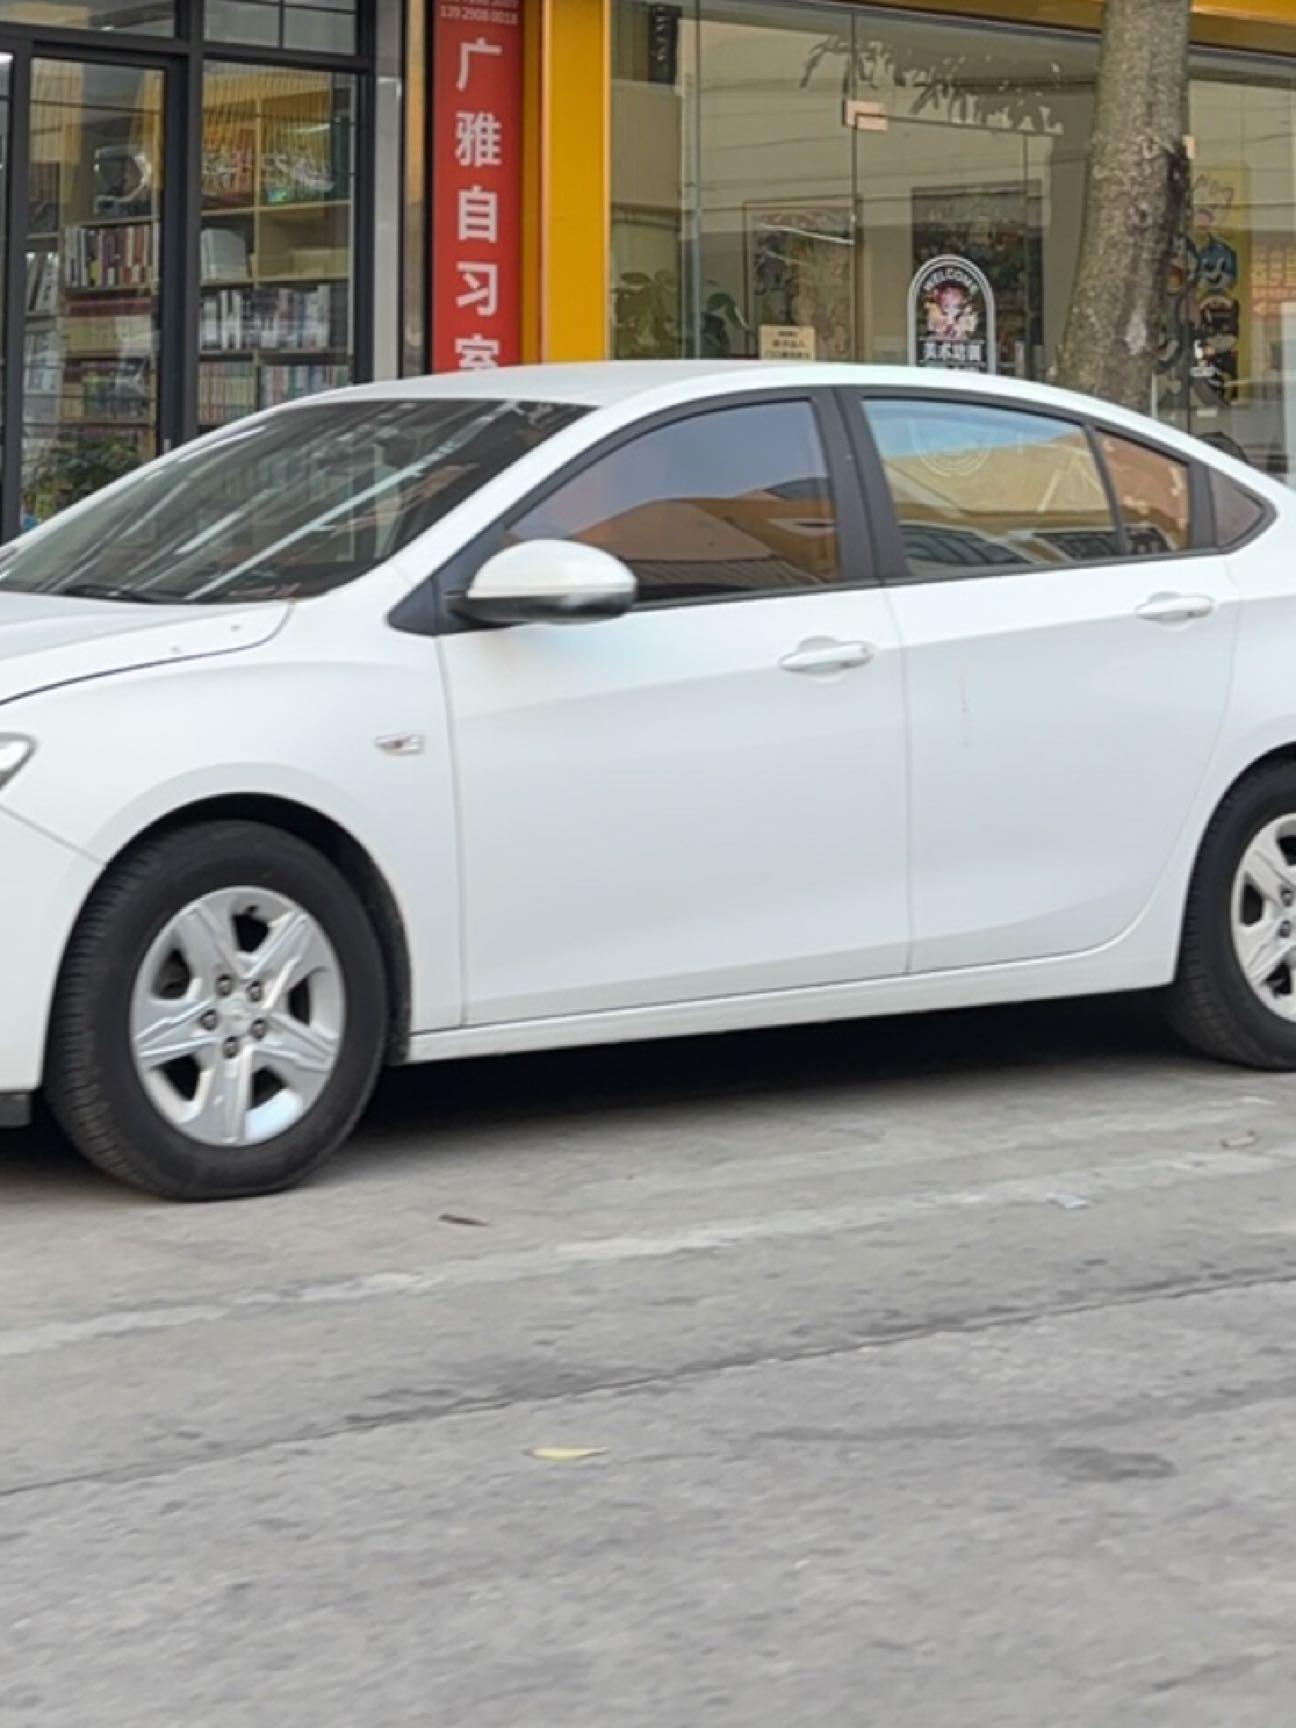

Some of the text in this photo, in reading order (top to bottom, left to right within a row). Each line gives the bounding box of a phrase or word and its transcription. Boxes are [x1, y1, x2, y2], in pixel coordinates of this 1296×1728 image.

[455, 37, 503, 371] 广雅自习室
